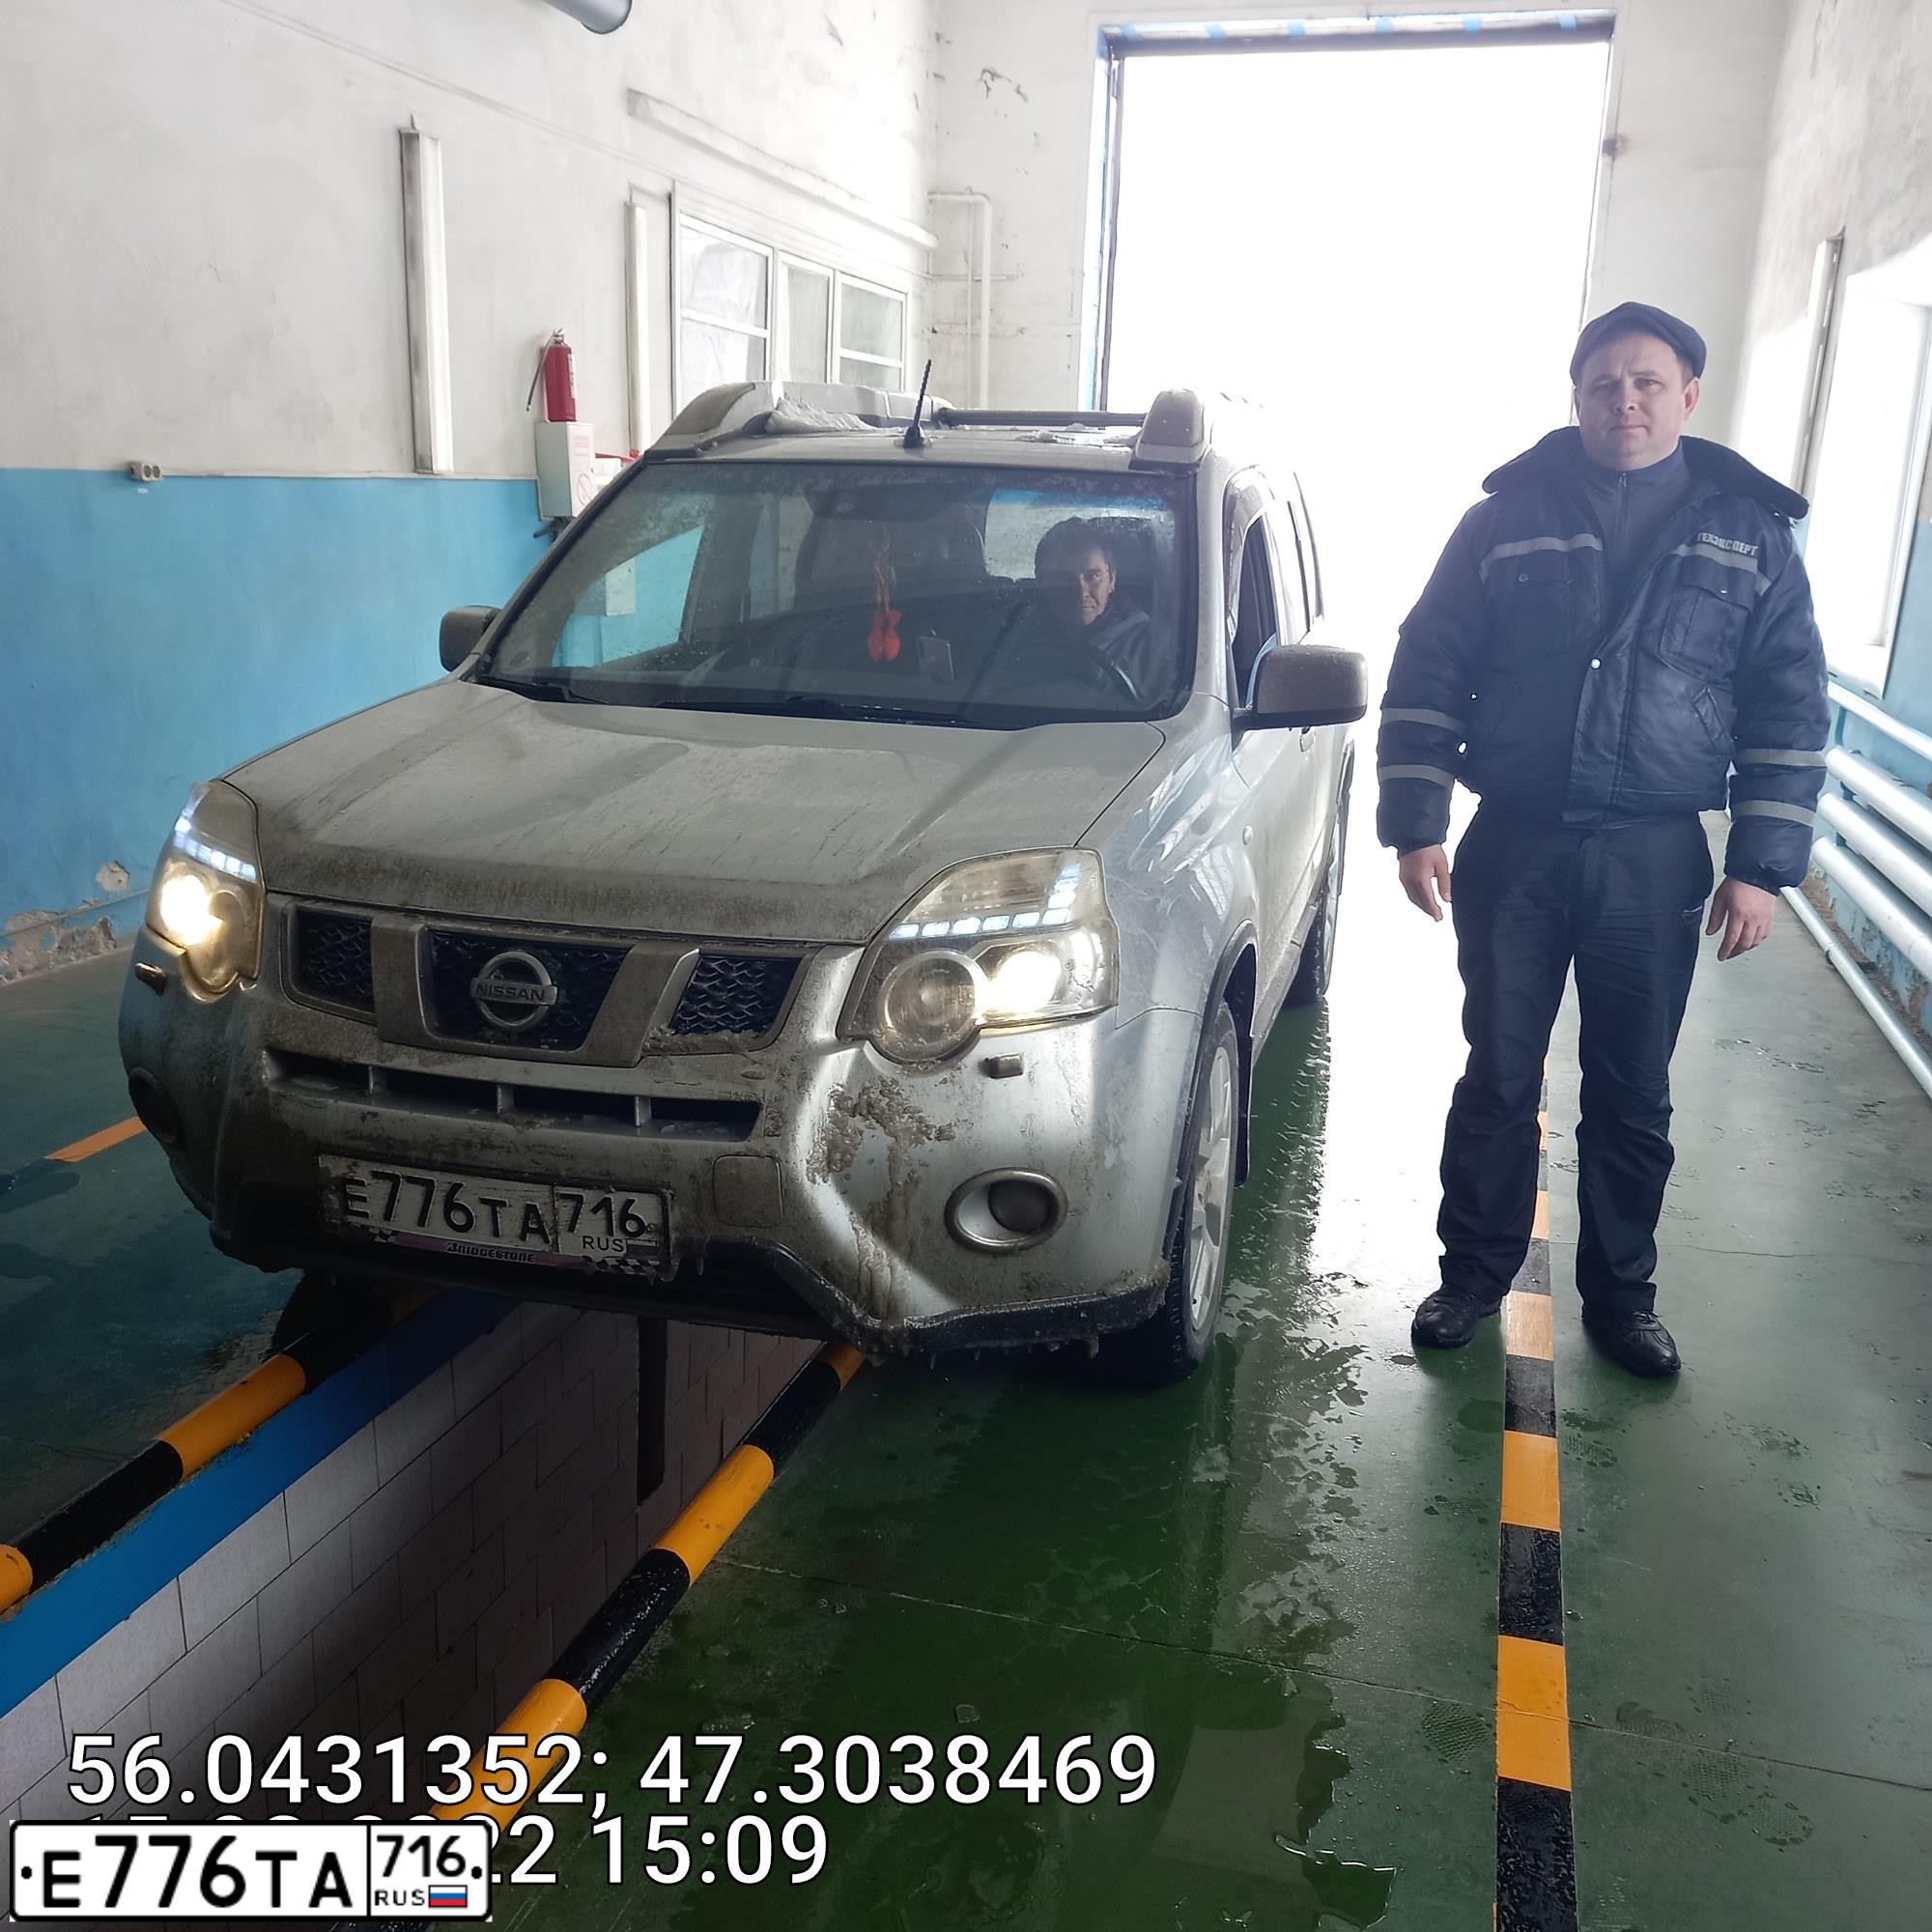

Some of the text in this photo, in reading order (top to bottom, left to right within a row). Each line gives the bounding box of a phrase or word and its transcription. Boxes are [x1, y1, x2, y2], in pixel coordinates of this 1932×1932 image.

[477, 983, 545, 1001] NISSAN
[344, 1170, 649, 1245] E776TA 716
[582, 1235, 625, 1253] RUS
